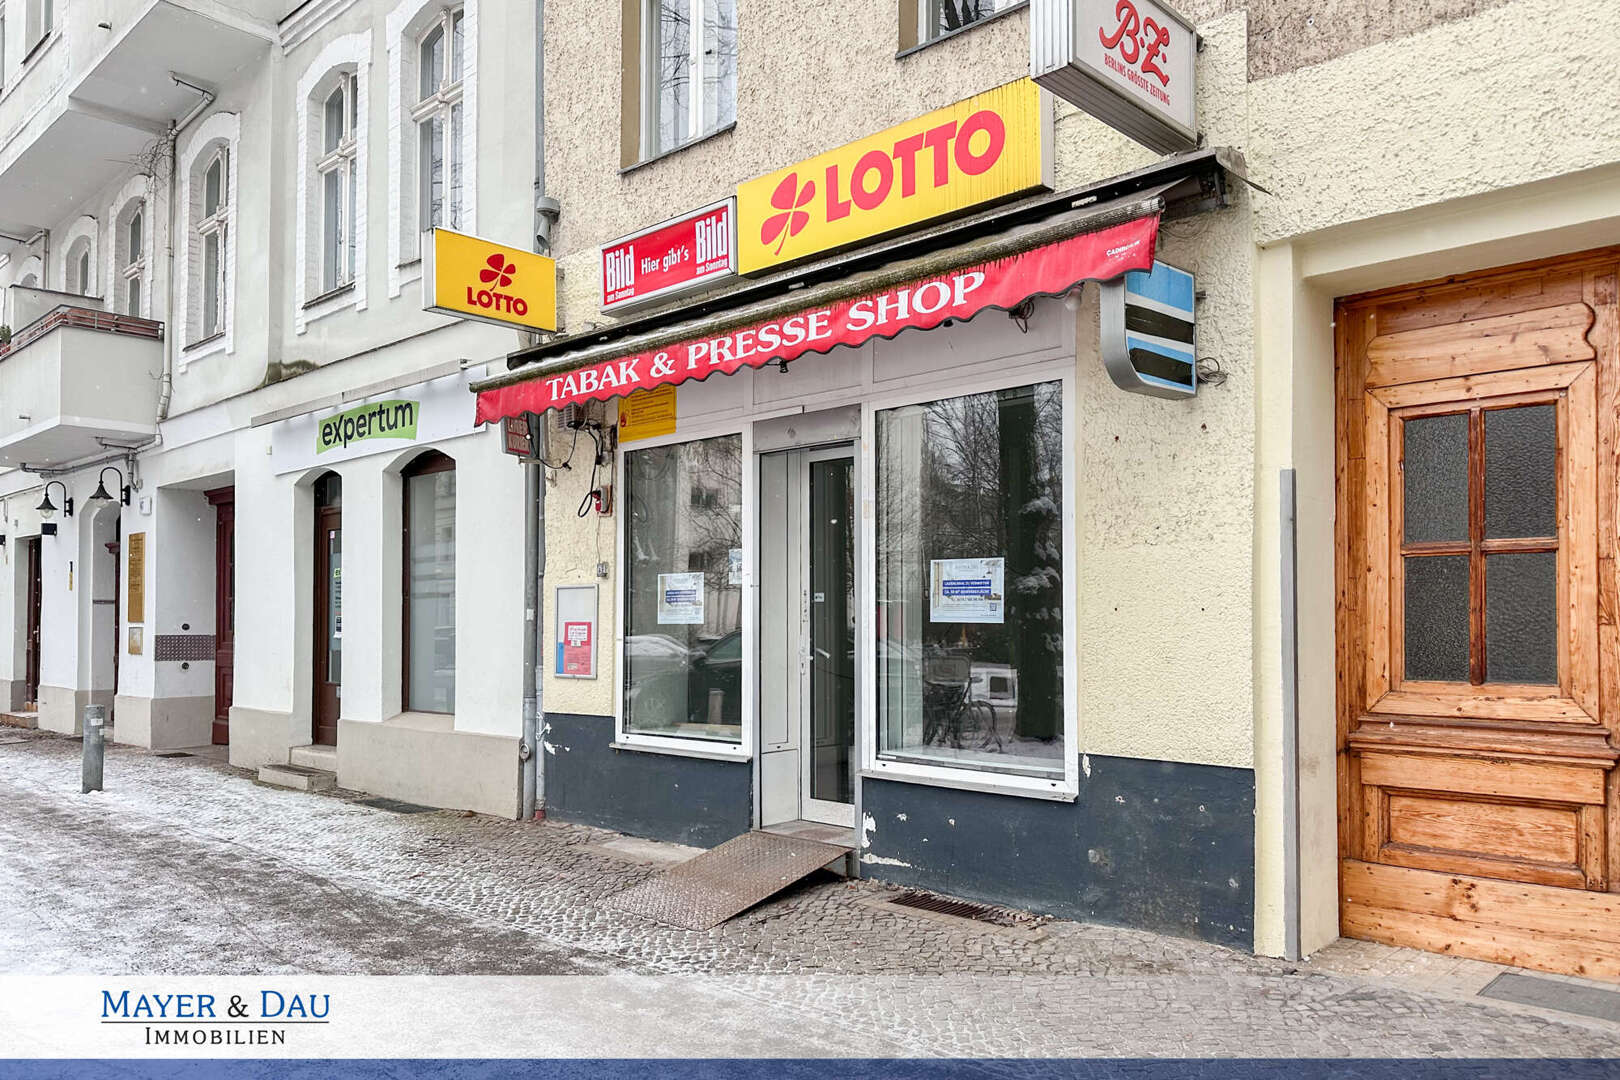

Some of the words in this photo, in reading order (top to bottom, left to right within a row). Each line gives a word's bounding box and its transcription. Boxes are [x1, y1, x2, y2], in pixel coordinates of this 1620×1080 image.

[1104, 53, 1126, 77] BERLINS
[1149, 83, 1171, 106] ZEITUNG
[826, 110, 1006, 223] LOTTO
[641, 257, 660, 275] Hier
[663, 245, 690, 273] gibt's
[695, 211, 728, 265] Bild
[605, 245, 635, 293] Bild
[705, 258, 728, 273] Sonntag
[466, 286, 528, 316] LOTTO
[545, 358, 641, 402] TABAK
[650, 352, 676, 378] &
[686, 311, 833, 370] PRESSE
[846, 271, 986, 332] SHOP
[322, 402, 413, 448] expertum
